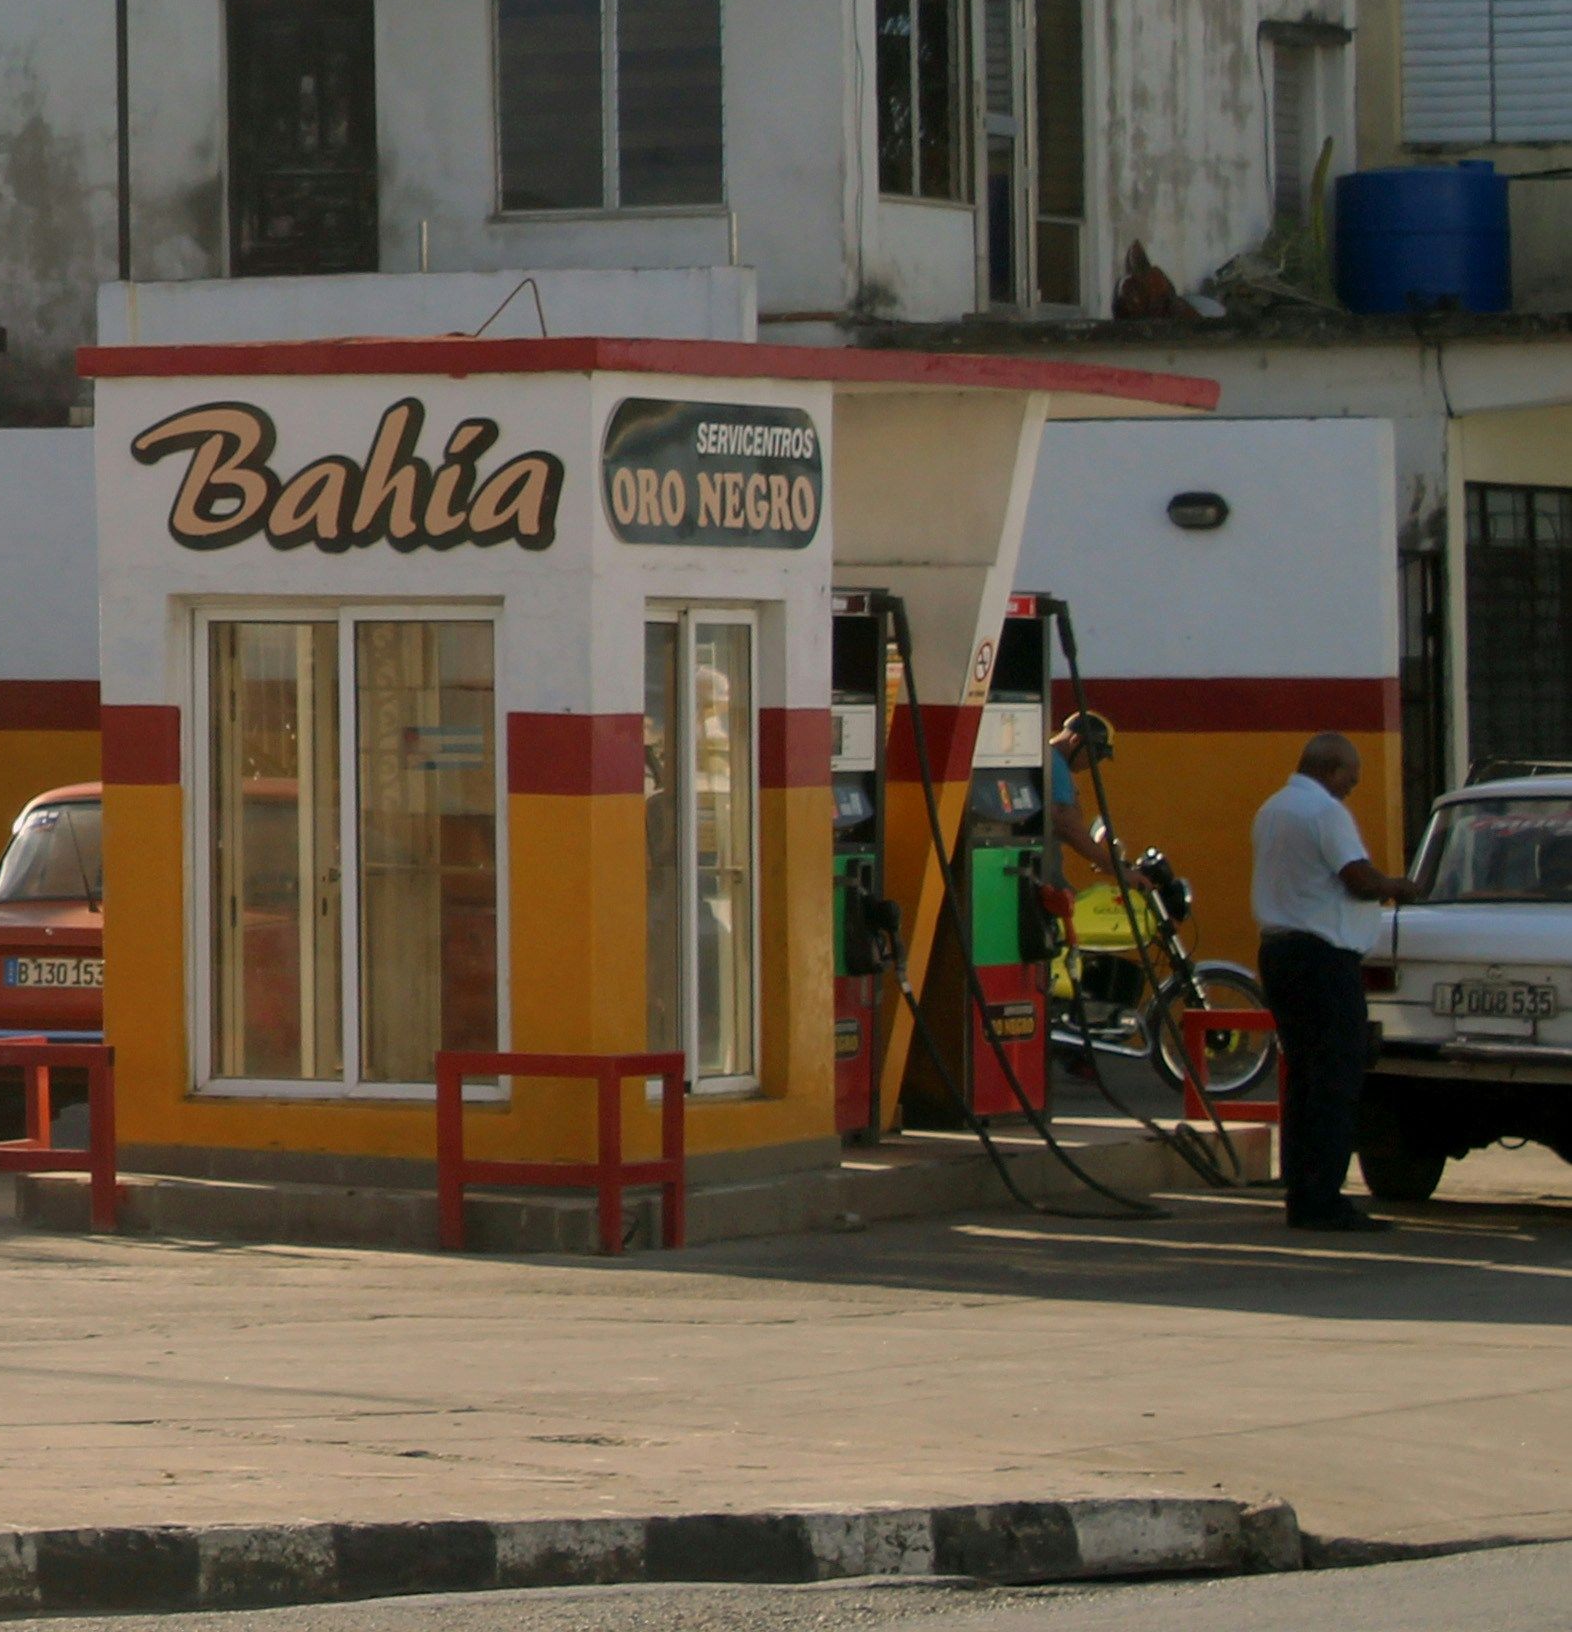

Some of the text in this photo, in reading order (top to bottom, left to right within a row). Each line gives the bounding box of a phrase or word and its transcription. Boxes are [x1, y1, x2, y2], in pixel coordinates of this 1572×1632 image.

[696, 422, 814, 460] SERVICENTROS
[611, 466, 817, 532] ORO NEGRO
